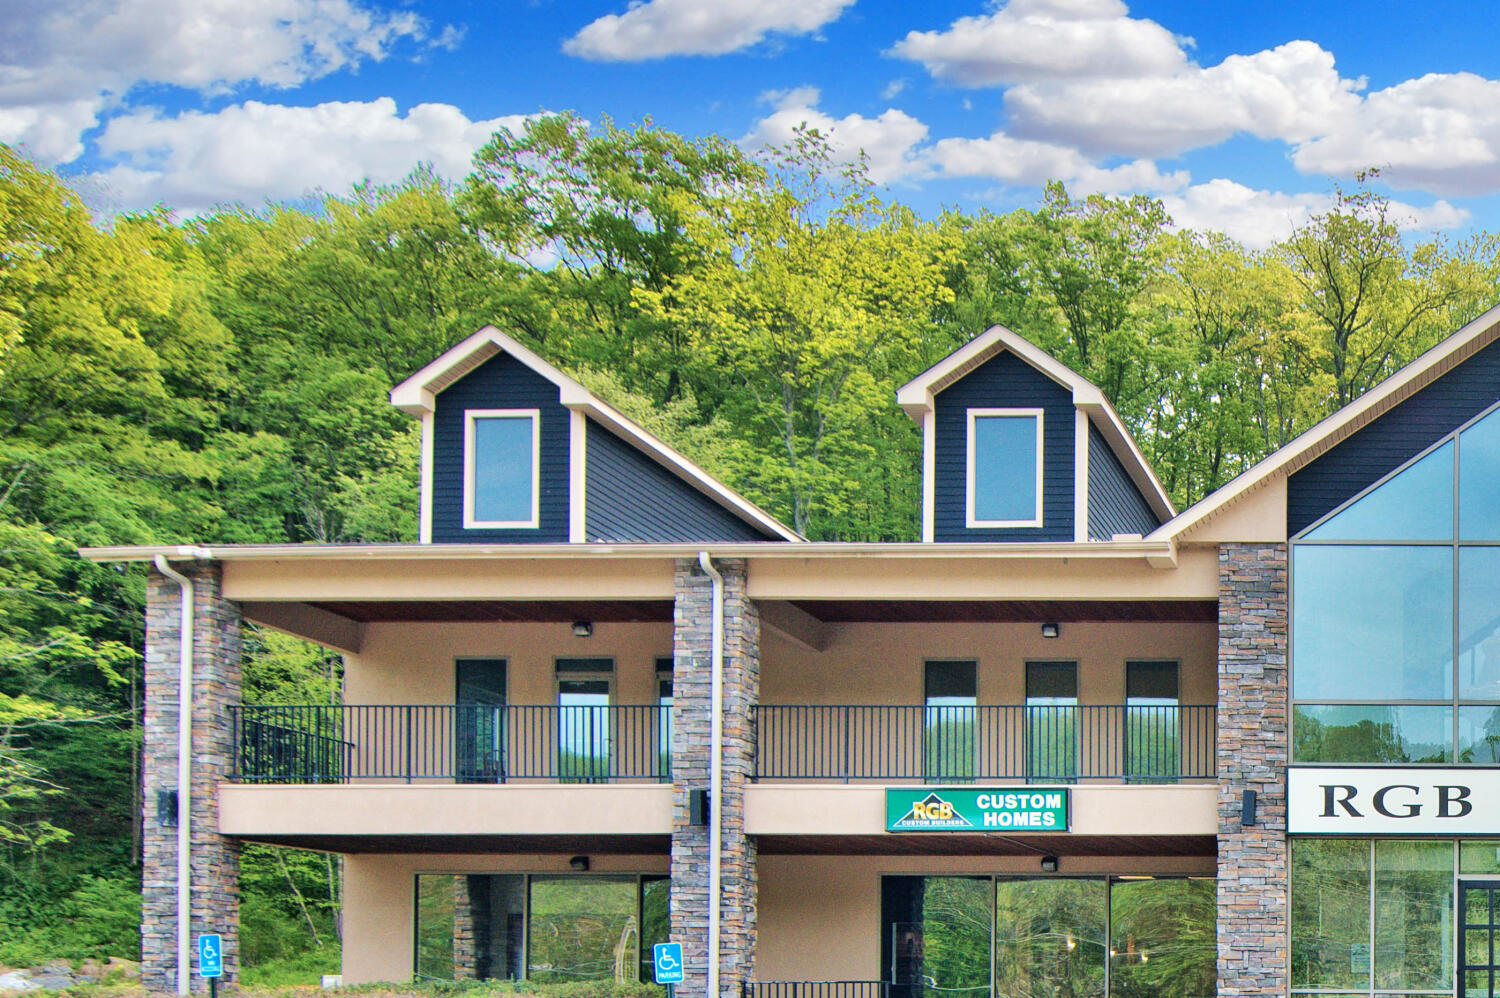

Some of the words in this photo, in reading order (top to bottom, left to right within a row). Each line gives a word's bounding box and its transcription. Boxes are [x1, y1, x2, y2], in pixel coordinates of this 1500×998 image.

[976, 794, 1062, 809] CUSTOM
[1318, 784, 1474, 819] RGB
[913, 802, 953, 820] RGB
[983, 811, 1056, 827] HOMES
[658, 971, 682, 979] PARKING
